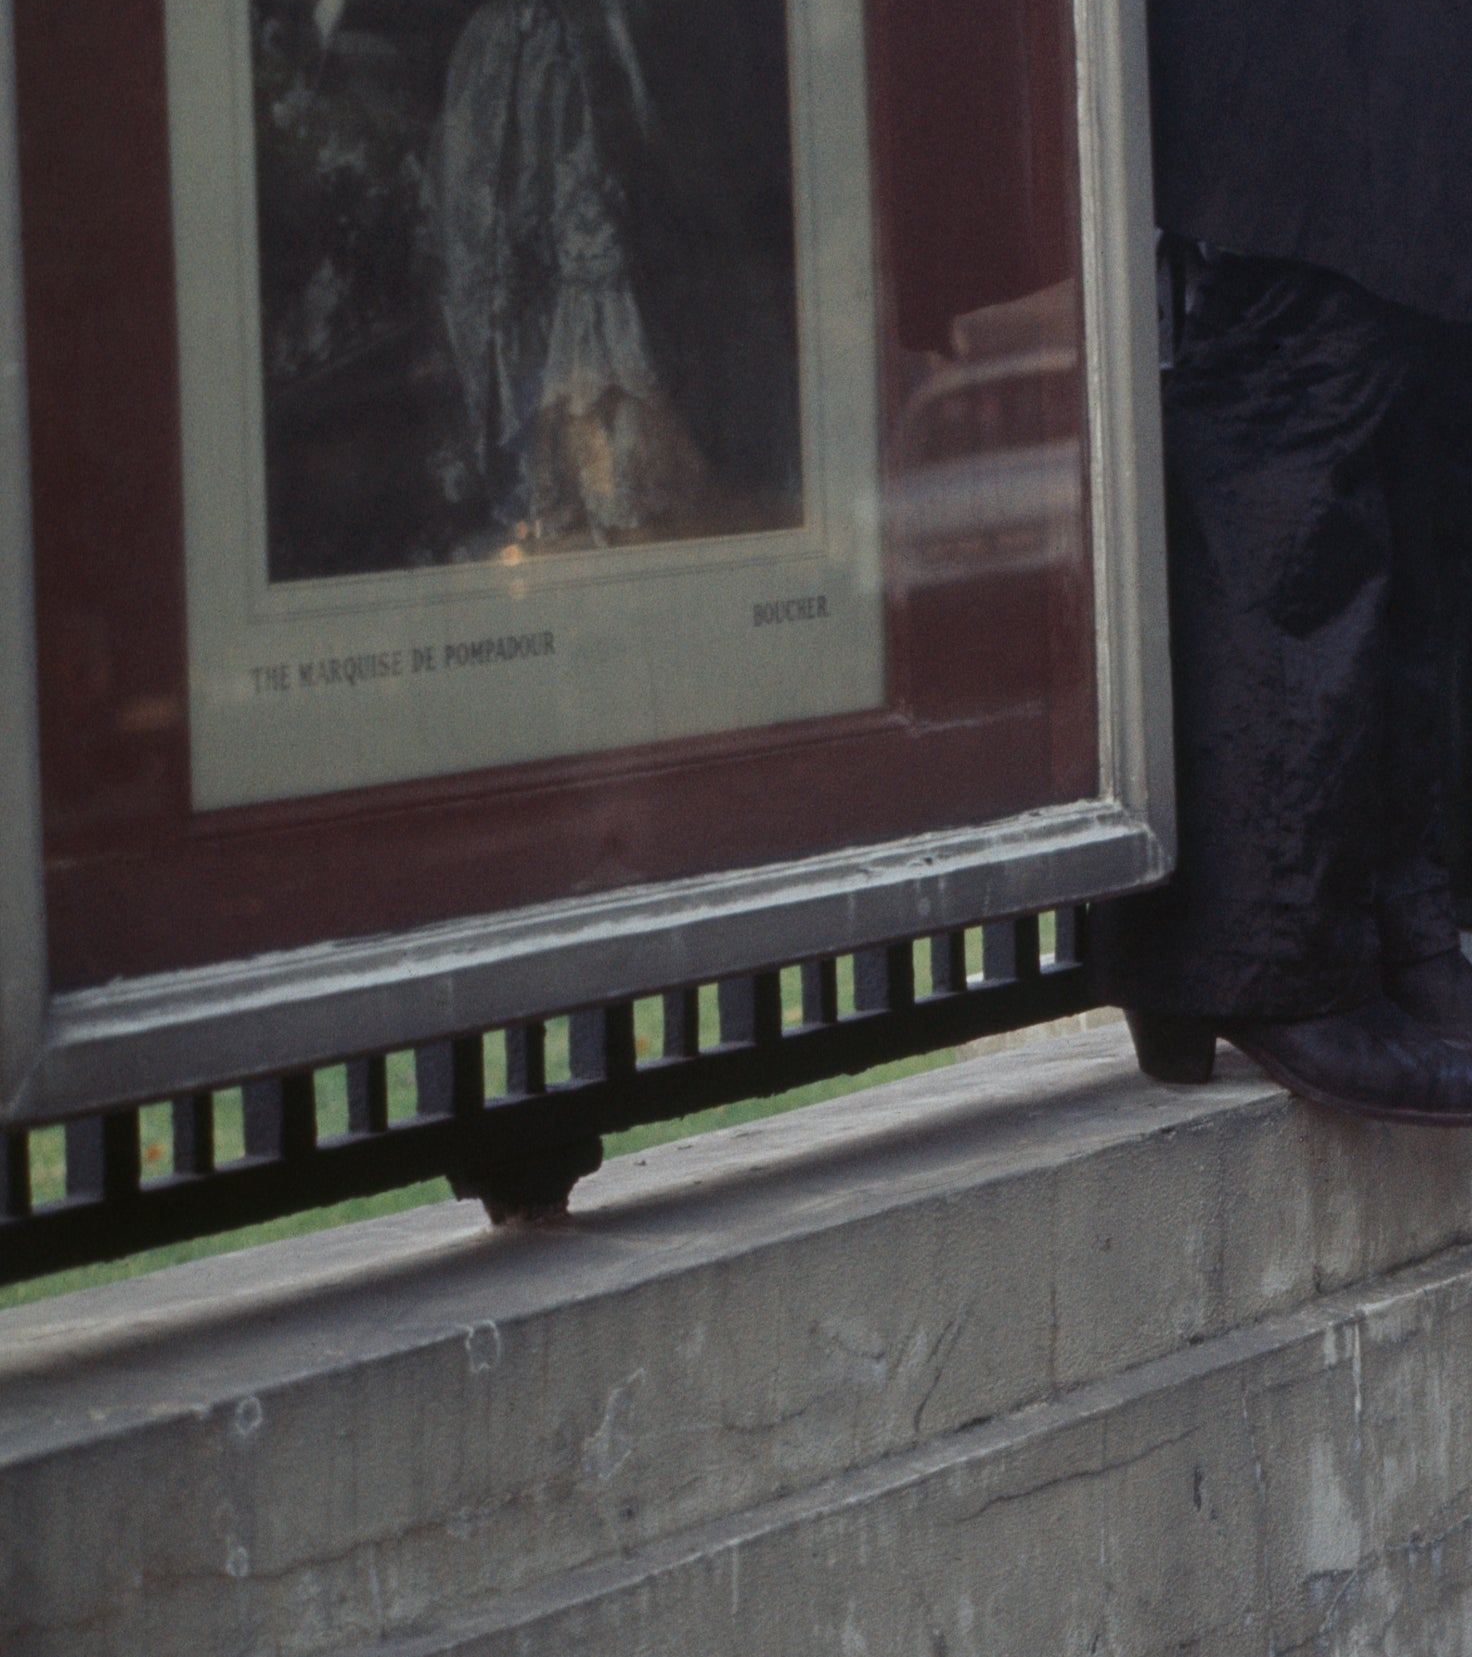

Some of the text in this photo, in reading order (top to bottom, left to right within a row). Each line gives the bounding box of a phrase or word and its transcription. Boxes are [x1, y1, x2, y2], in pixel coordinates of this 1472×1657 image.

[752, 595, 830, 628] BOUCHER
[250, 630, 556, 695] THE MARQUISE DE POMPADOUR
